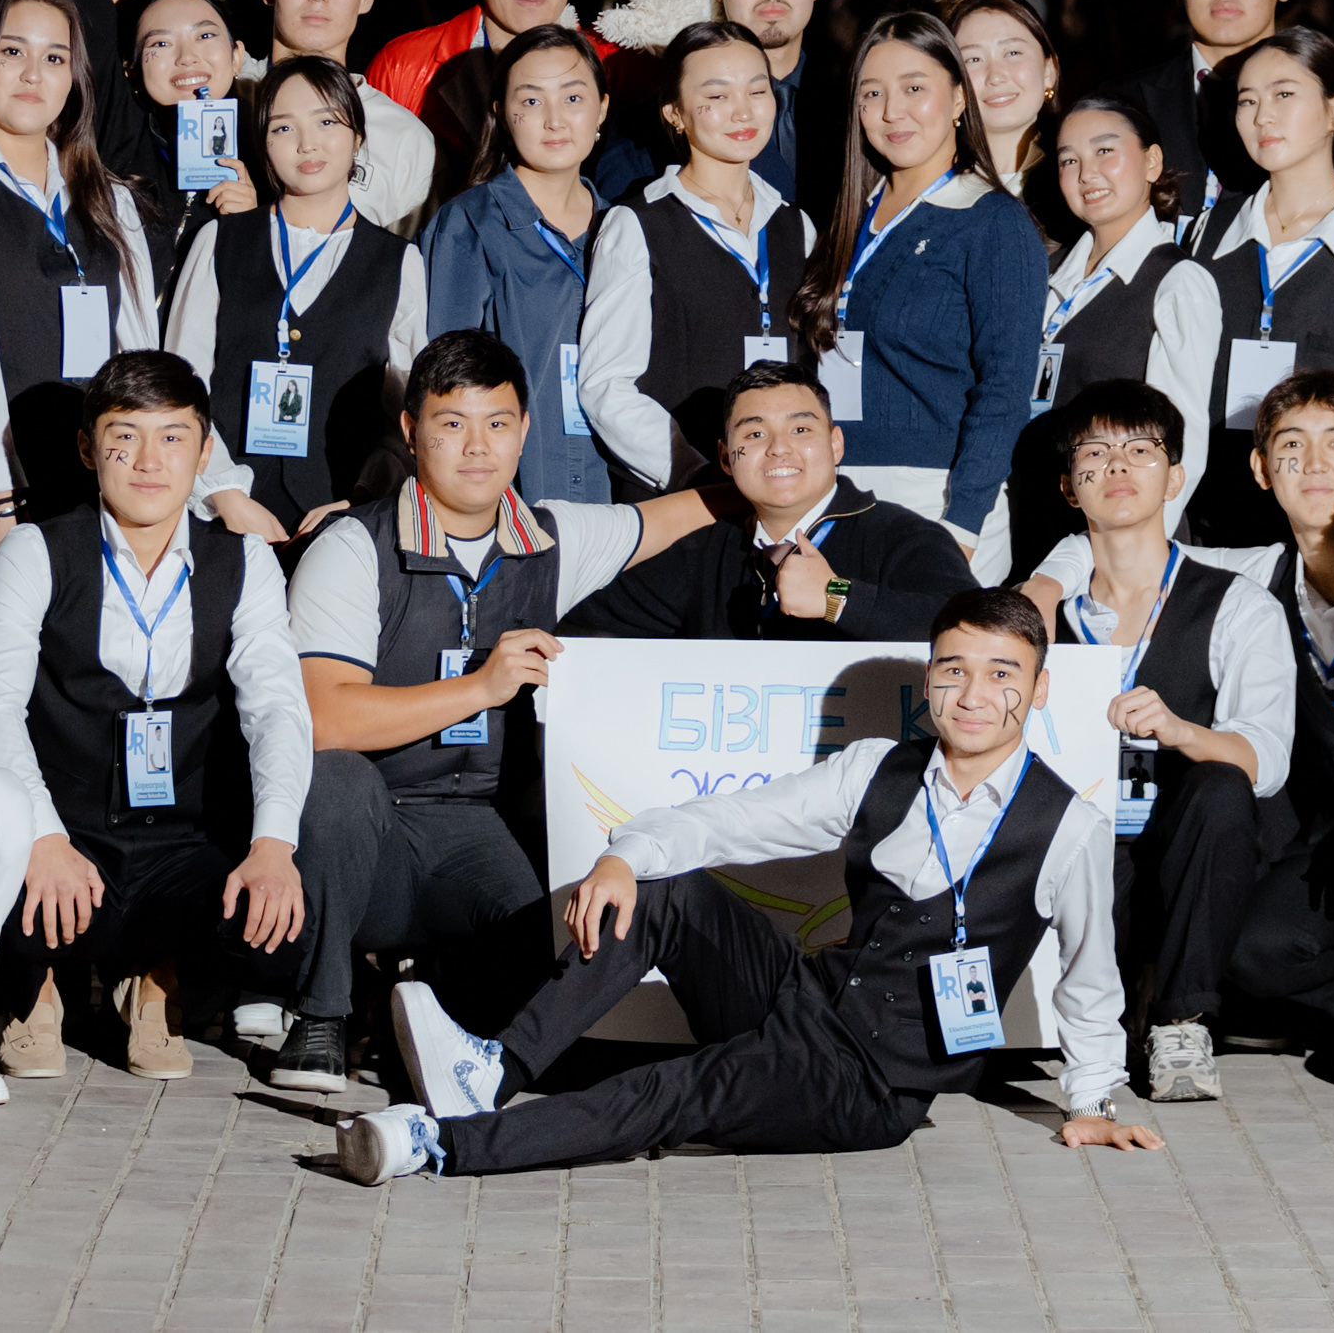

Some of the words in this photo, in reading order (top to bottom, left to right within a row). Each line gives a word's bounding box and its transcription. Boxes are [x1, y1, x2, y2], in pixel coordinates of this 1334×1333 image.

[145, 49, 159, 63] JR
[697, 104, 711, 114] JR
[512, 113, 526, 125] JR
[430, 437, 444, 451] JR
[105, 449, 129, 465] JR
[731, 446, 746, 466] JR
[1275, 456, 1300, 474] JR
[1078, 470, 1094, 486] JR
[127, 719, 145, 756] JR
[936, 963, 960, 1000] JR
